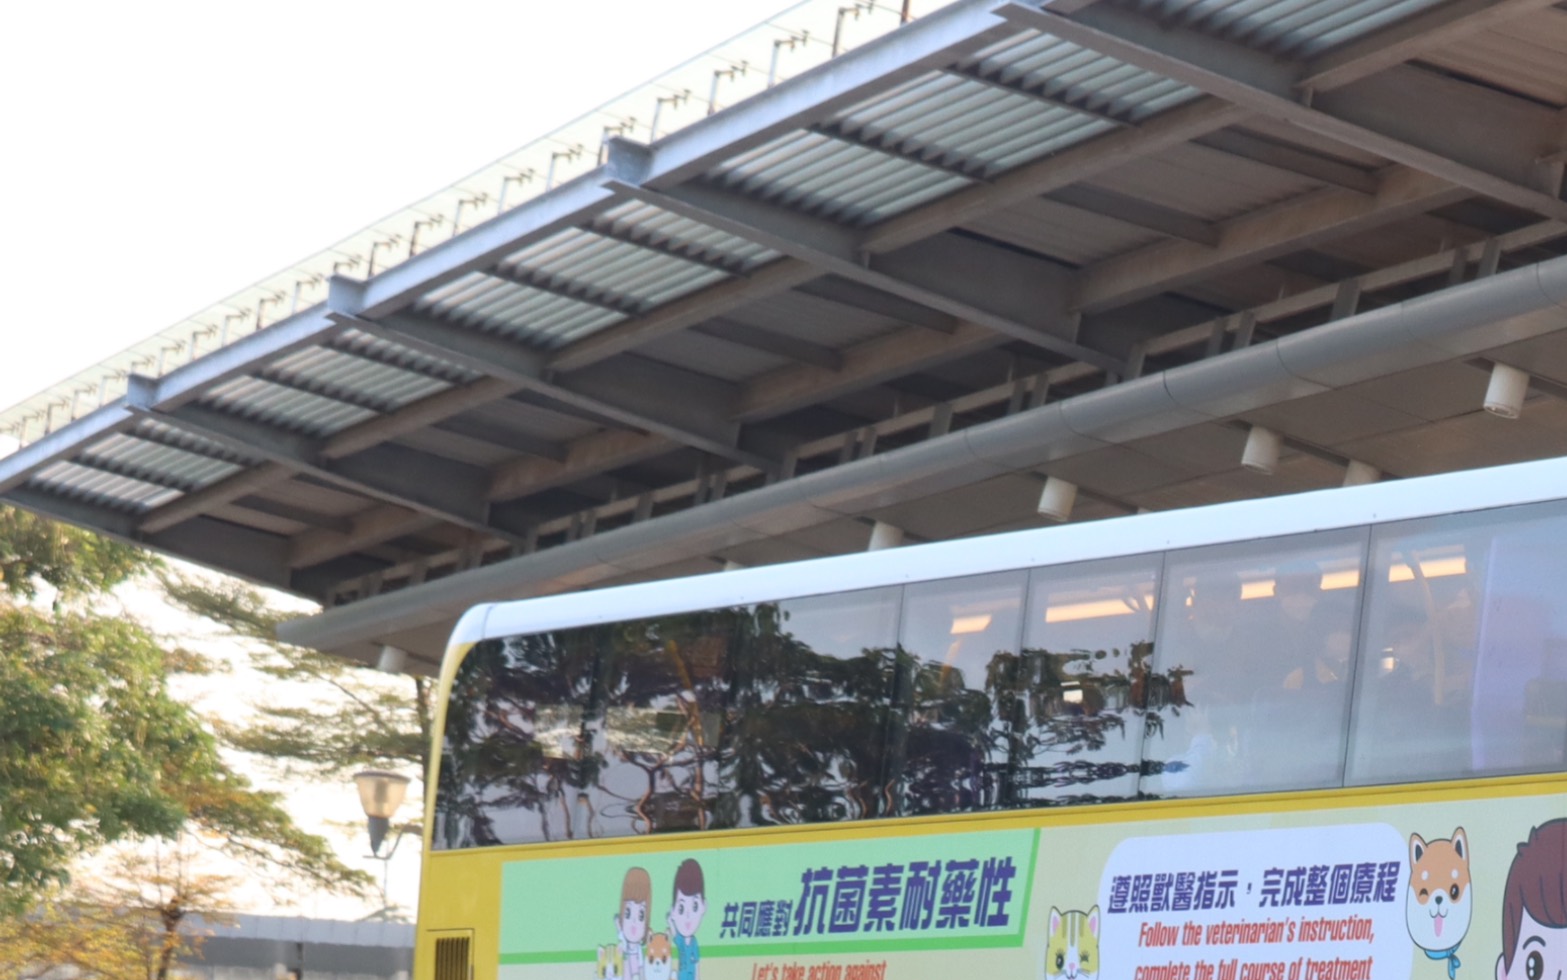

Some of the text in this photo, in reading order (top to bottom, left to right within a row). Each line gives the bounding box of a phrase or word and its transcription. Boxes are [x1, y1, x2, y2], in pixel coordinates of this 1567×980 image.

[1138, 914, 1375, 947] Follow the veterinarian's instruction,
